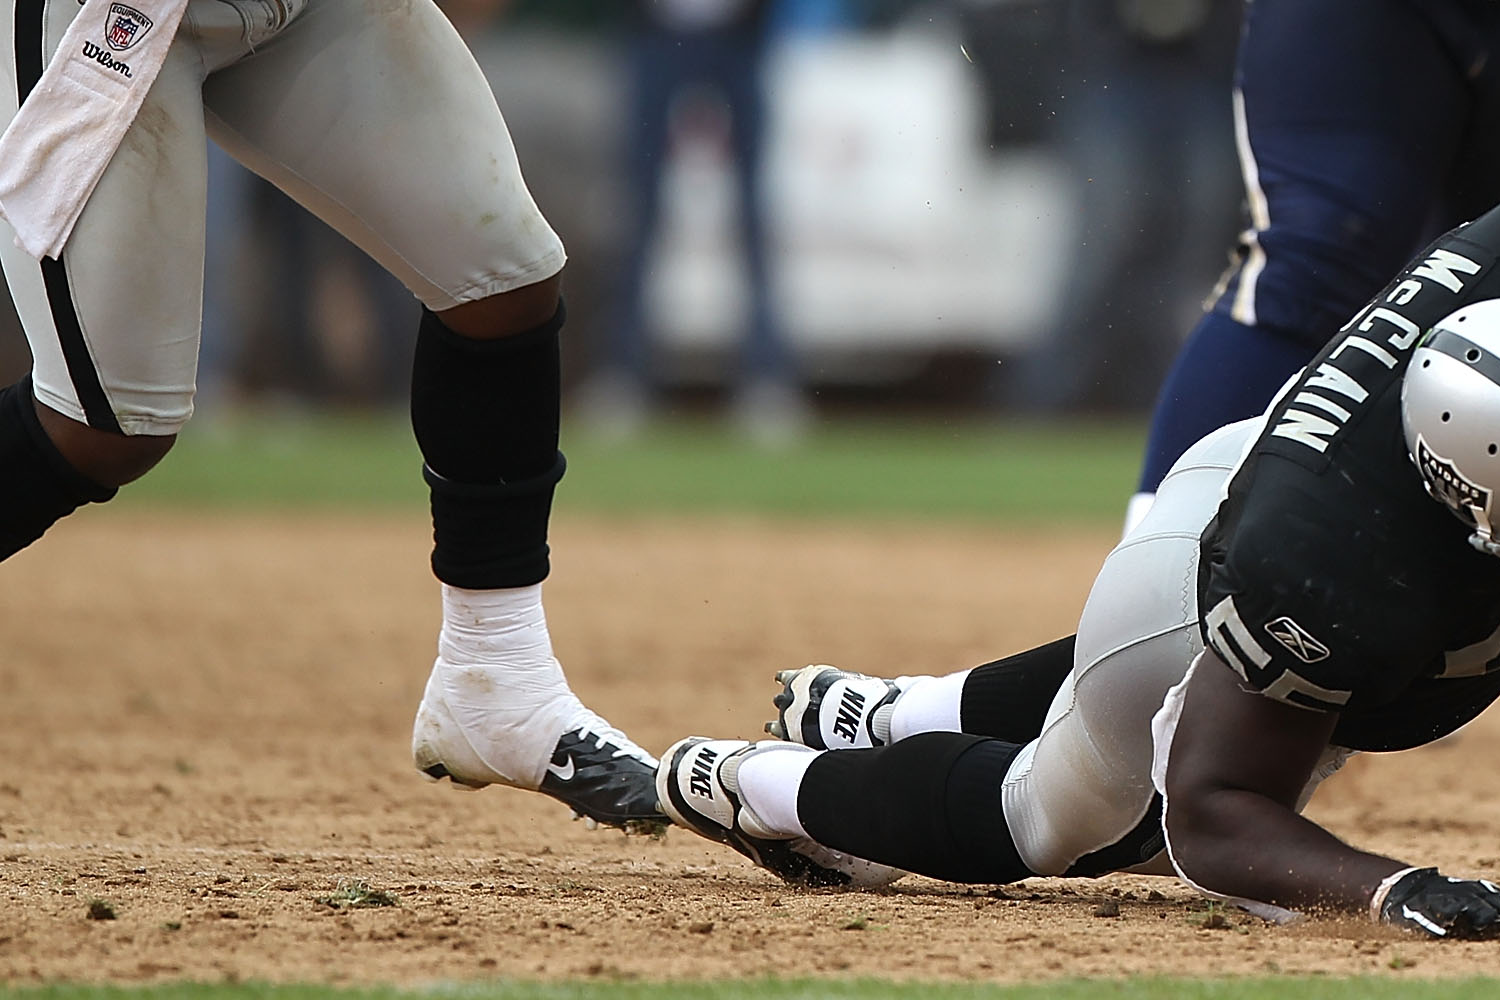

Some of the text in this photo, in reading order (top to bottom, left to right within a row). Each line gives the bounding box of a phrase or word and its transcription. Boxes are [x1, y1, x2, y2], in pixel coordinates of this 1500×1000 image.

[110, 27, 131, 45] NFL
[112, 6, 150, 29] EQUIPMENT
[82, 41, 132, 78] Wilson
[1422, 449, 1479, 498] RAIDERS
[833, 686, 866, 744] NIKE
[690, 747, 718, 801] NIKE
